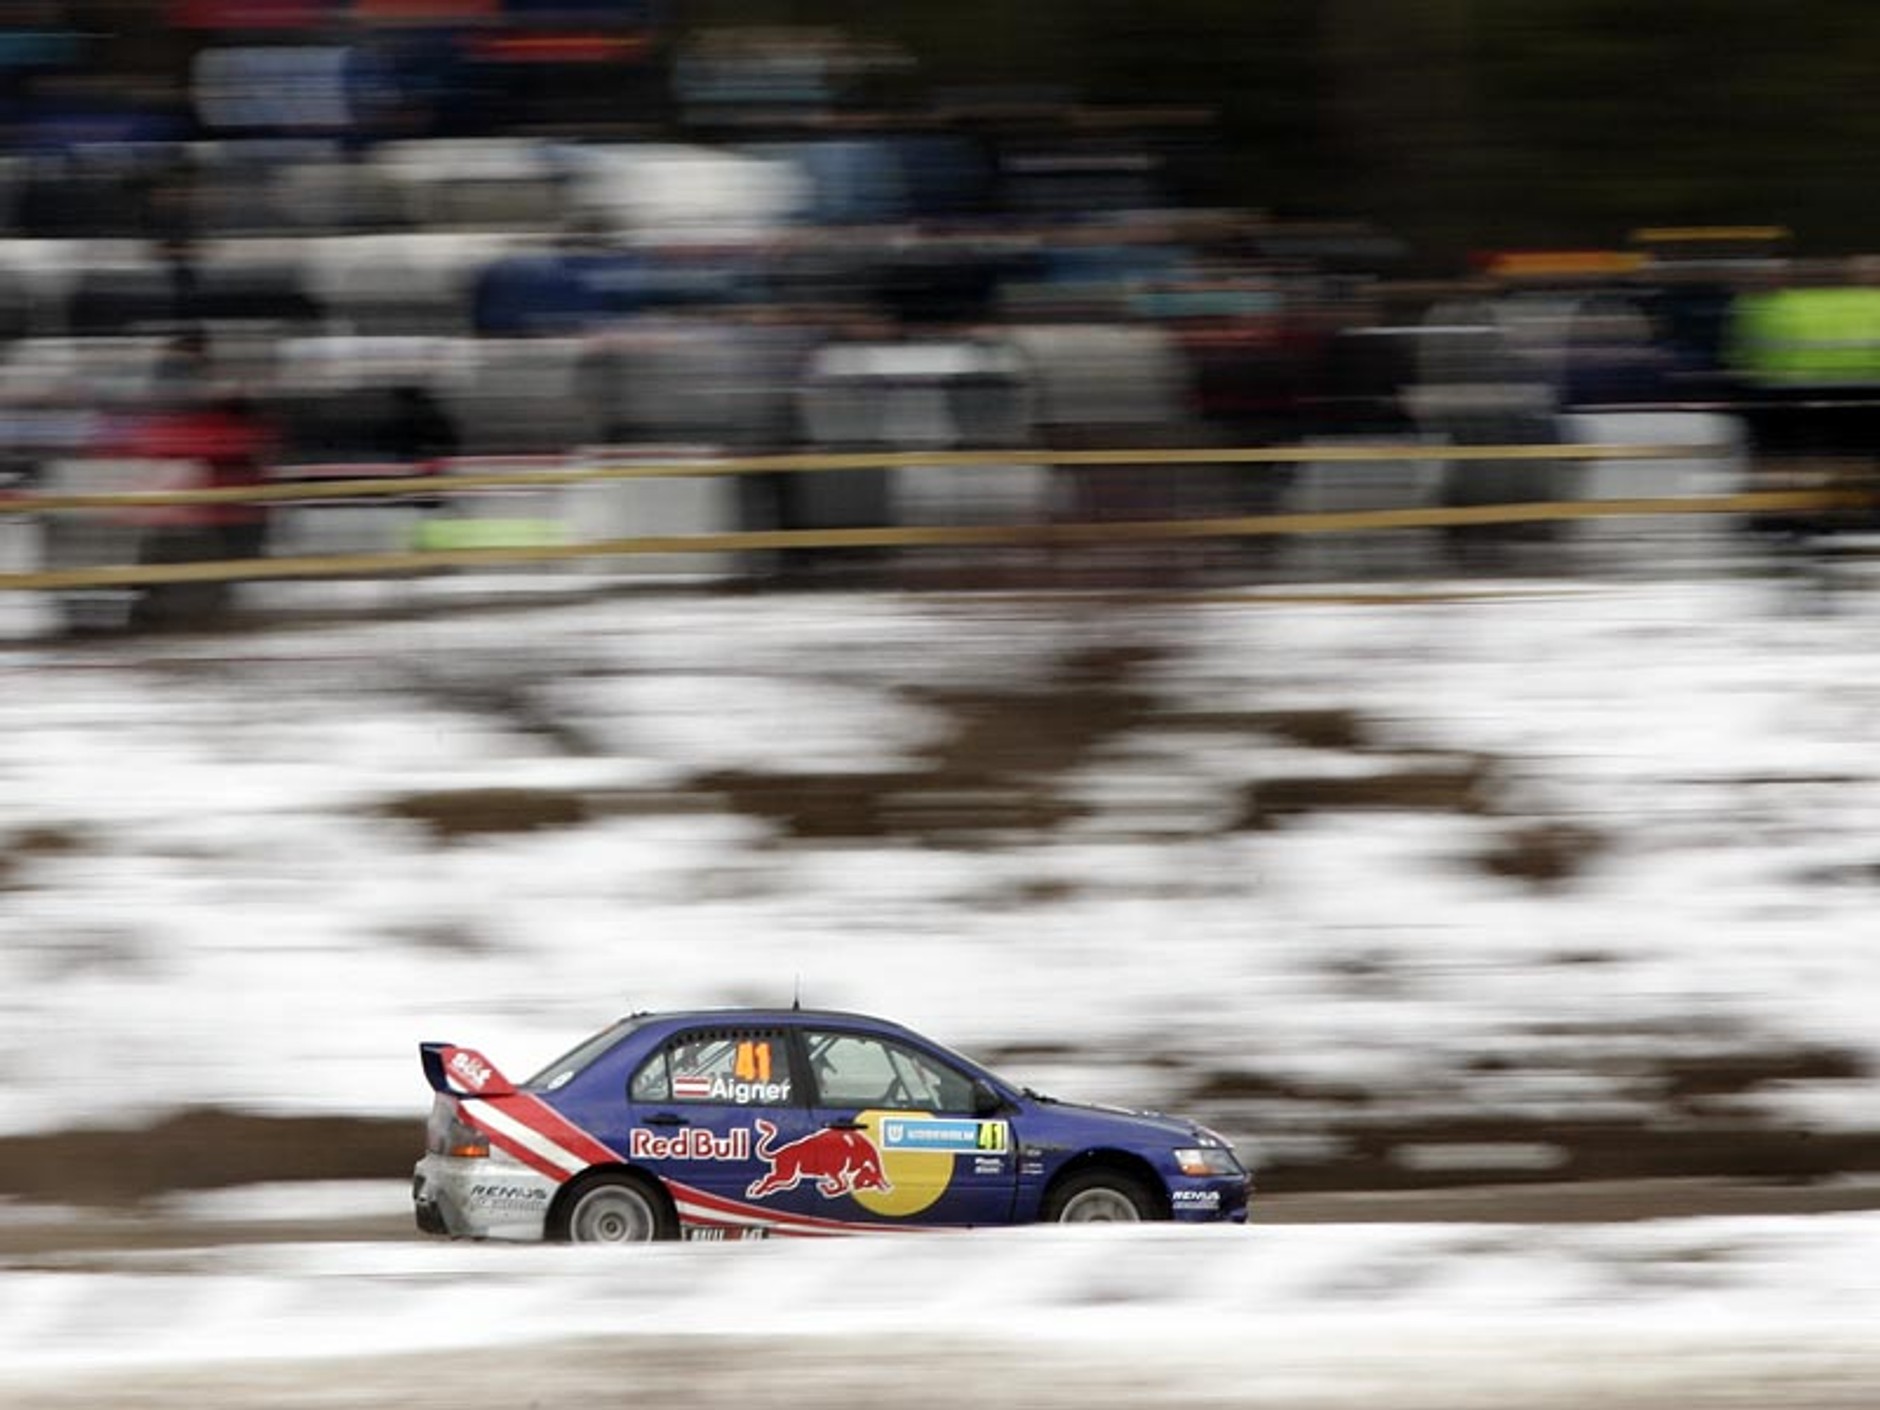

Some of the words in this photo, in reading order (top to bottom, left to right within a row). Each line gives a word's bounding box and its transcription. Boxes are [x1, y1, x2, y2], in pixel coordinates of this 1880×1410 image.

[735, 1040, 771, 1081] 41
[712, 1077, 790, 1103] Aigner
[630, 1128, 690, 1159] Red
[691, 1128, 750, 1160] Bull
[979, 1122, 1002, 1149] 41
